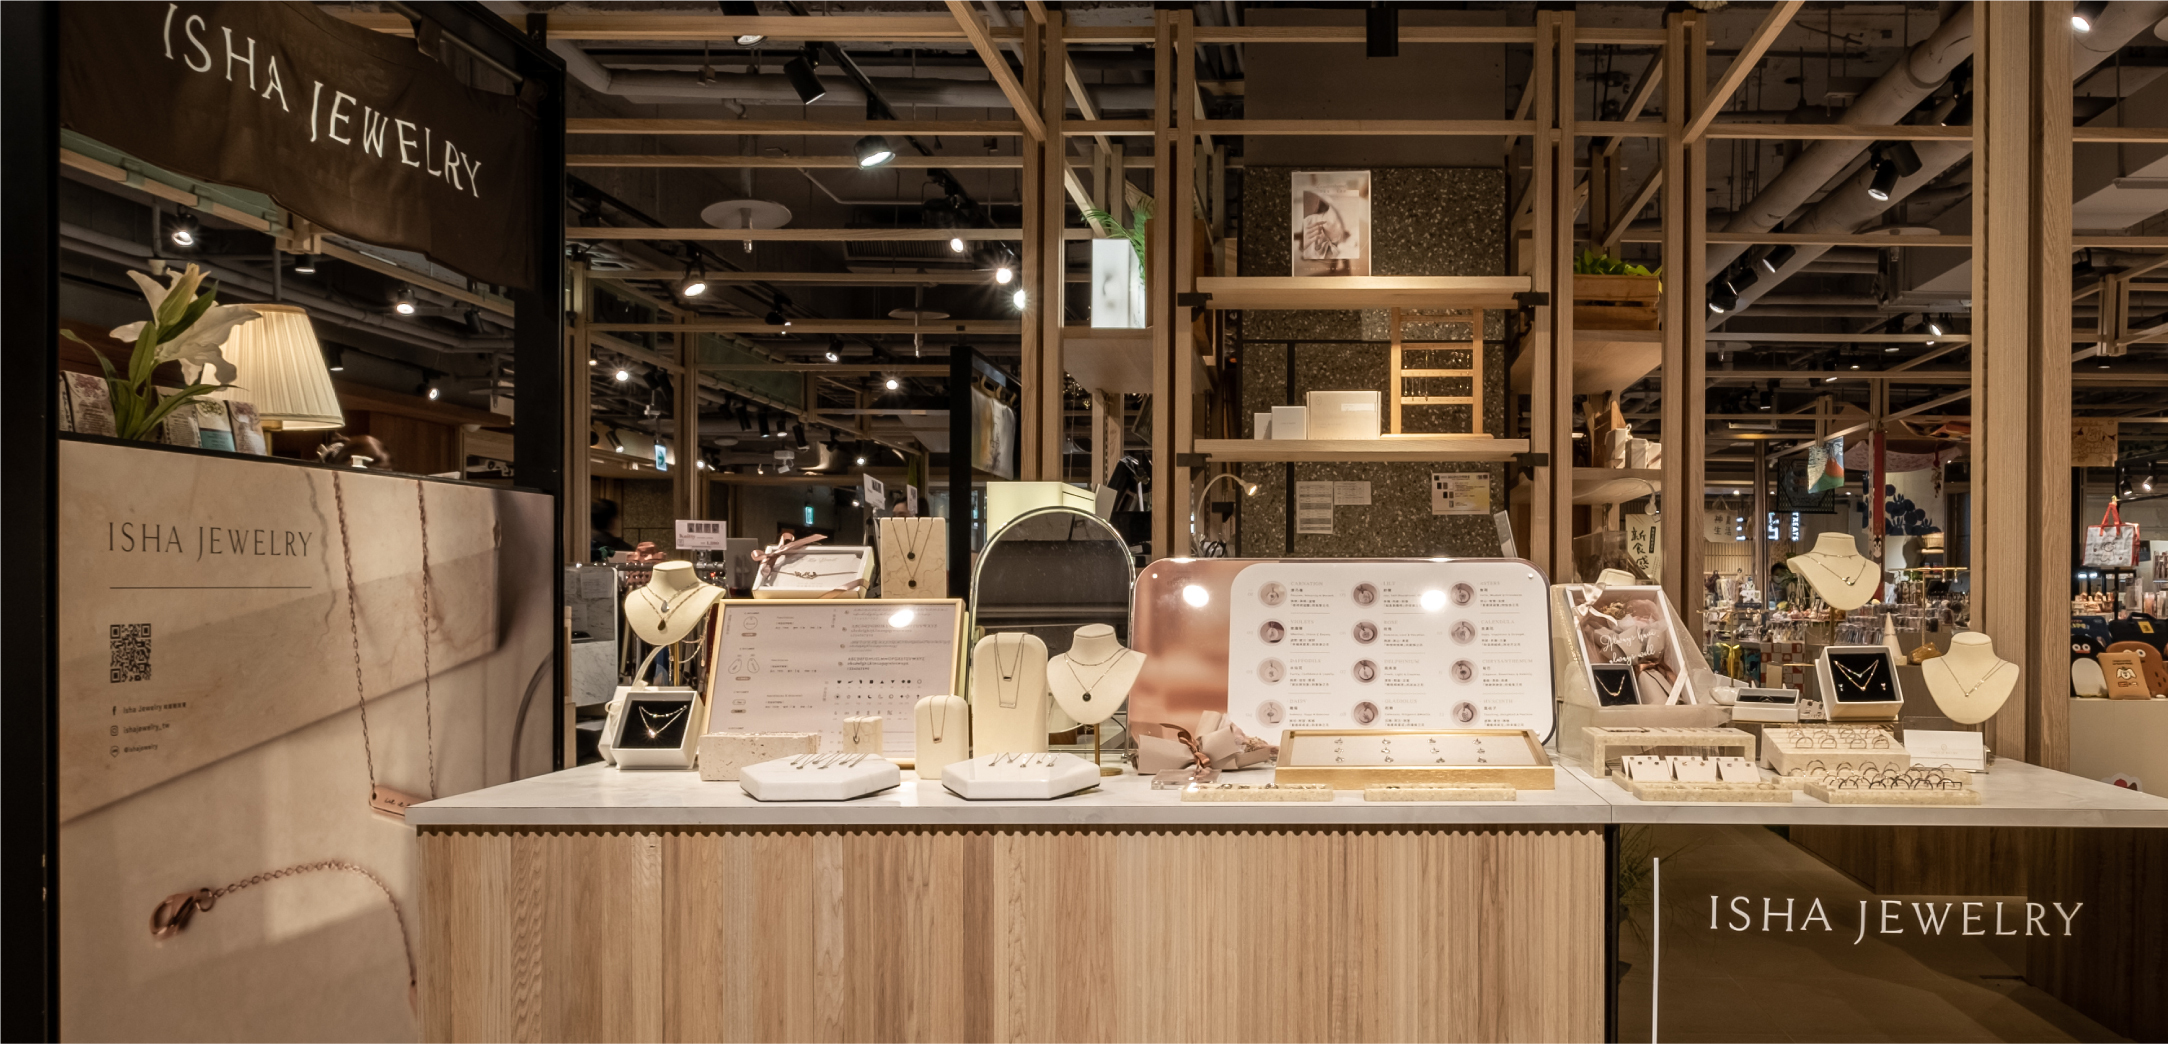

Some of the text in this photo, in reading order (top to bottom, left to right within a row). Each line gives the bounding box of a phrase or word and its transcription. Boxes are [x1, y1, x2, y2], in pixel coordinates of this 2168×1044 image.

[164, 3, 481, 198] ISHA JEWELRY
[109, 522, 313, 563] ISHA JEWELRY
[1631, 526, 1649, 570] 新食感
[1791, 511, 1800, 542] TREATS
[1710, 895, 2084, 945] ISHA JEWELRY
